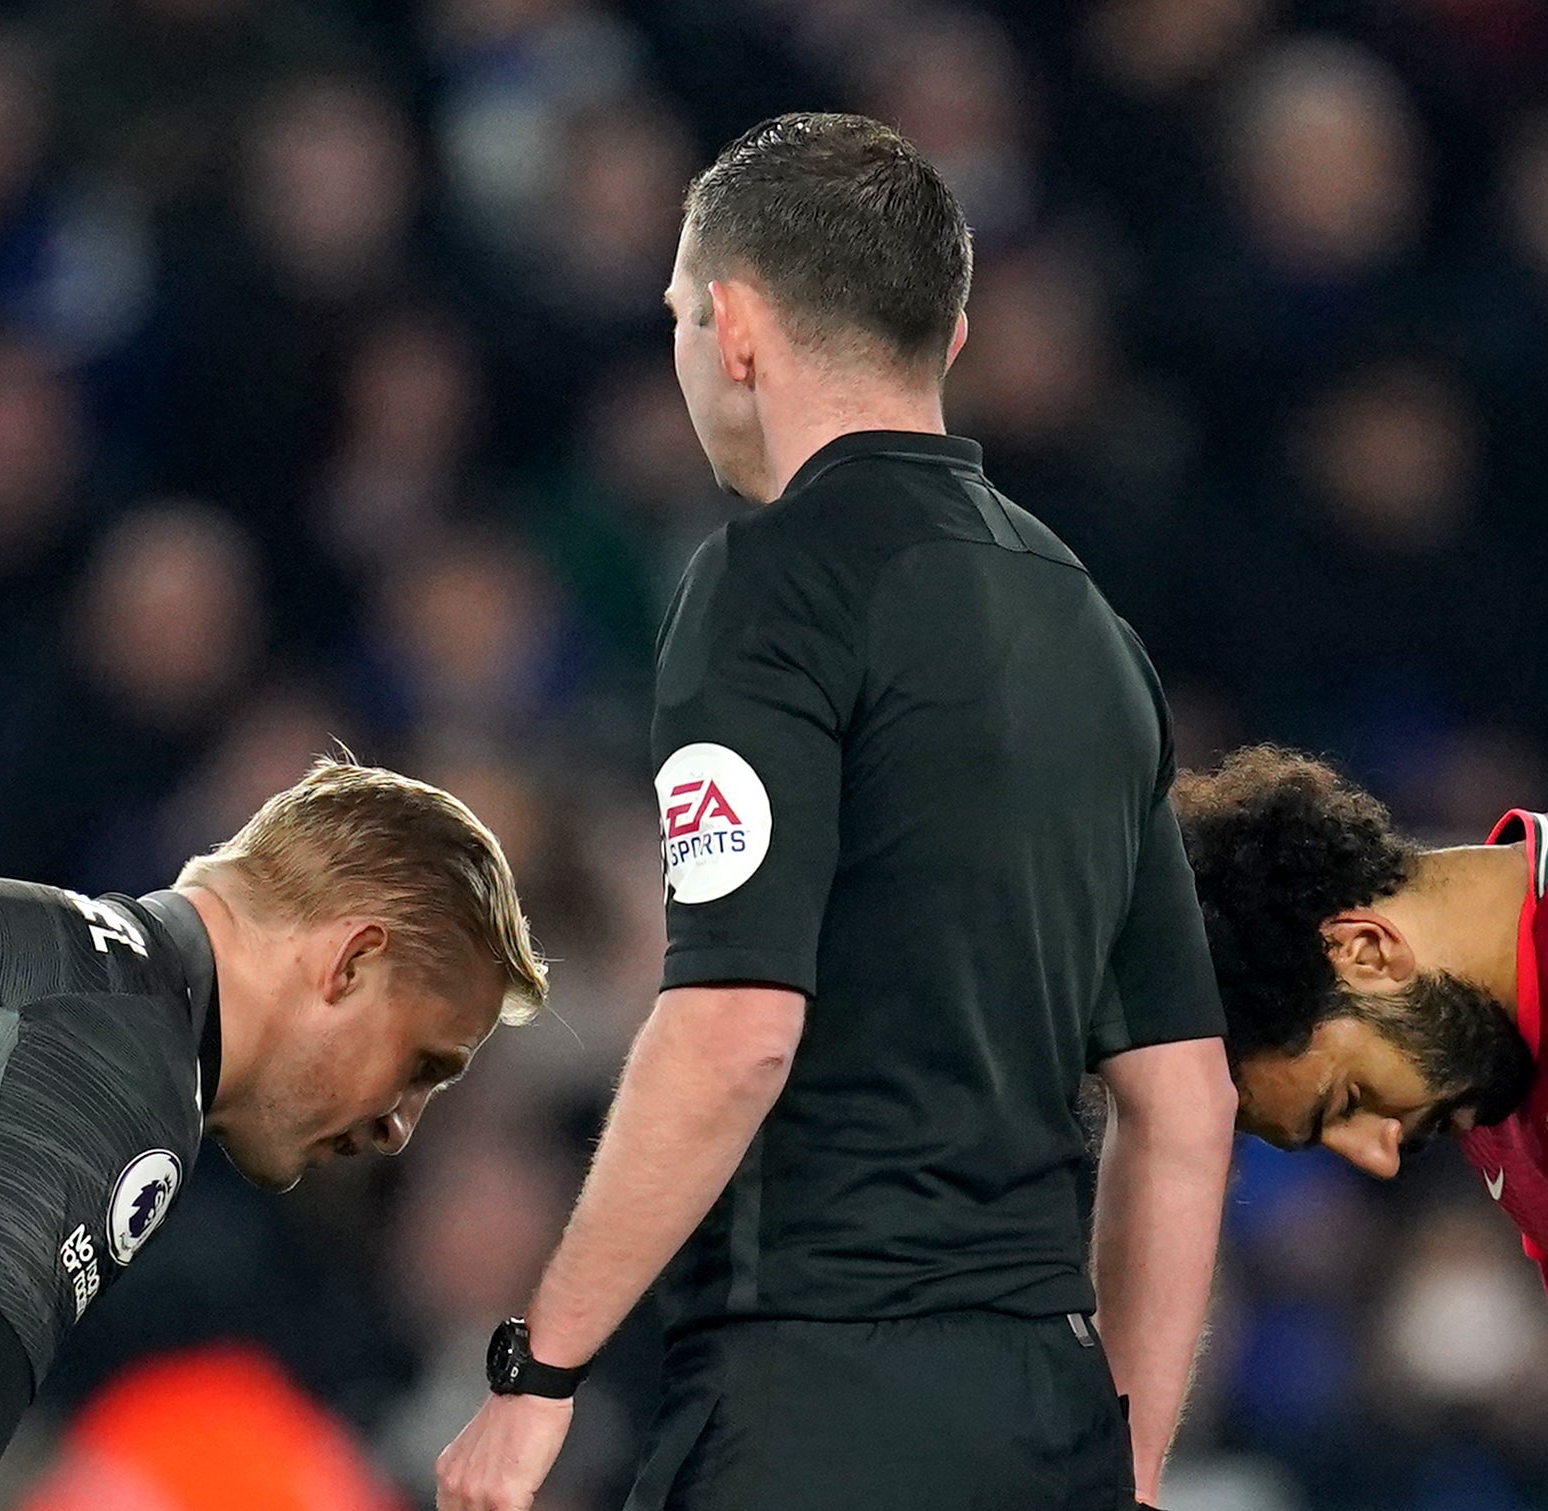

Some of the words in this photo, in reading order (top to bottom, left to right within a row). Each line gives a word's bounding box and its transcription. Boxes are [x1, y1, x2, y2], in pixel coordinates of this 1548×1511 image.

[665, 779, 743, 840] EA
[669, 830, 746, 867] SPORTS
[69, 1223, 94, 1263] No
